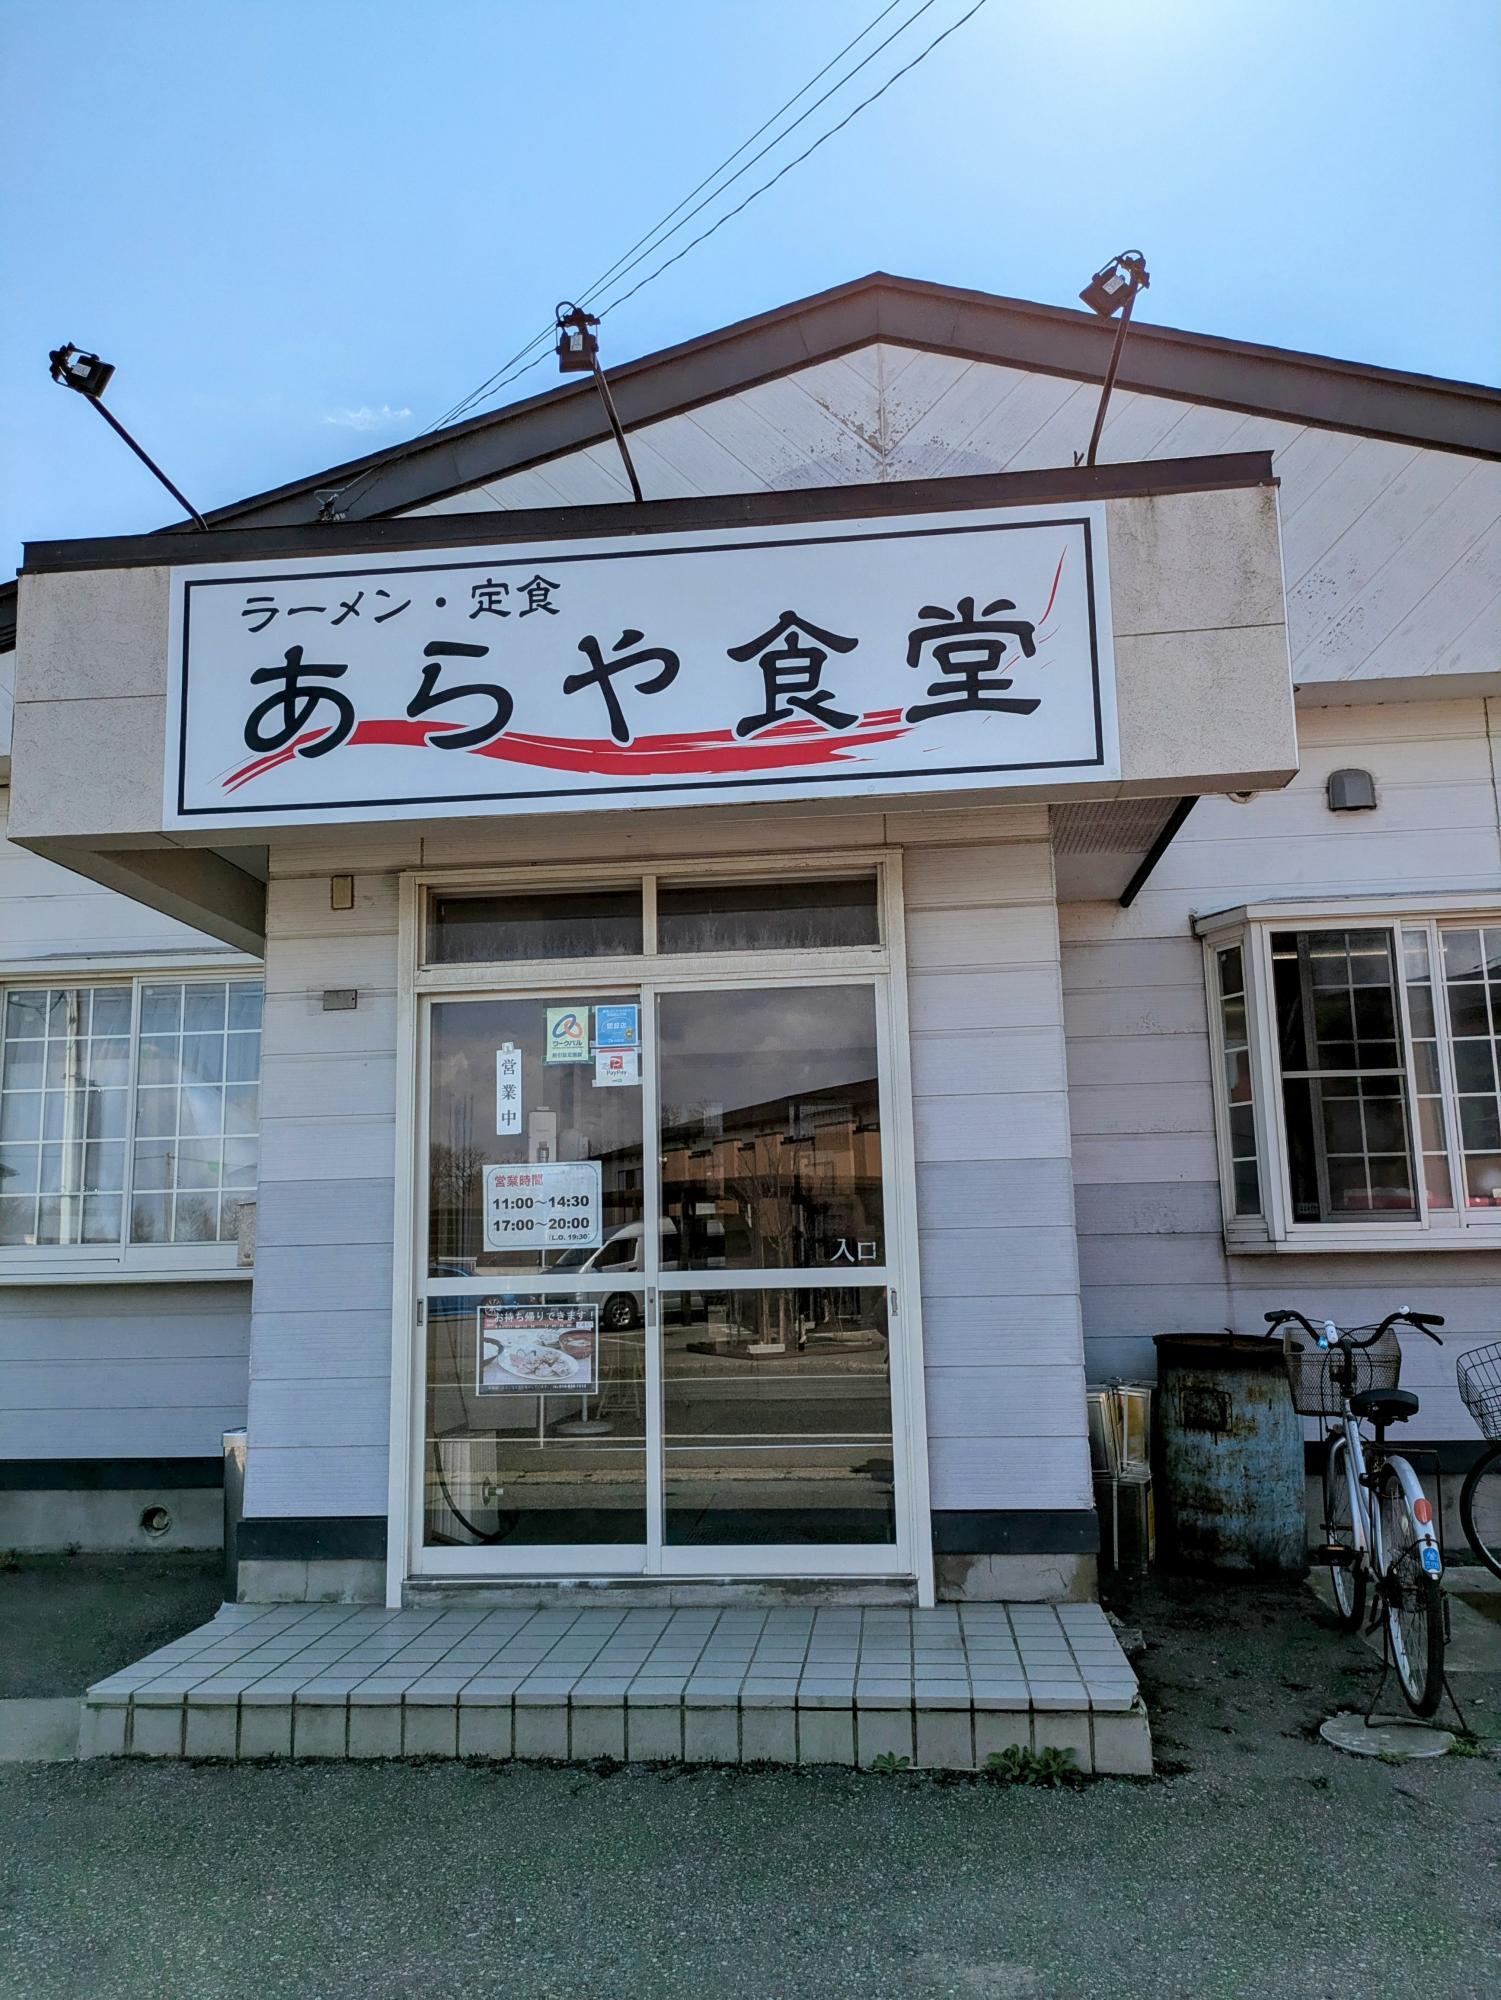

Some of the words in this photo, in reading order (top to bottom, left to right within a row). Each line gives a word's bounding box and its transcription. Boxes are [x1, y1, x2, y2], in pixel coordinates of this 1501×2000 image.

[241, 574, 561, 633] ラーメン・定食
[243, 596, 1042, 759] あらや食堂
[501, 1058, 517, 1127] 営業中
[494, 1174, 544, 1188] 営業時間
[830, 1238, 876, 1263] 入口
